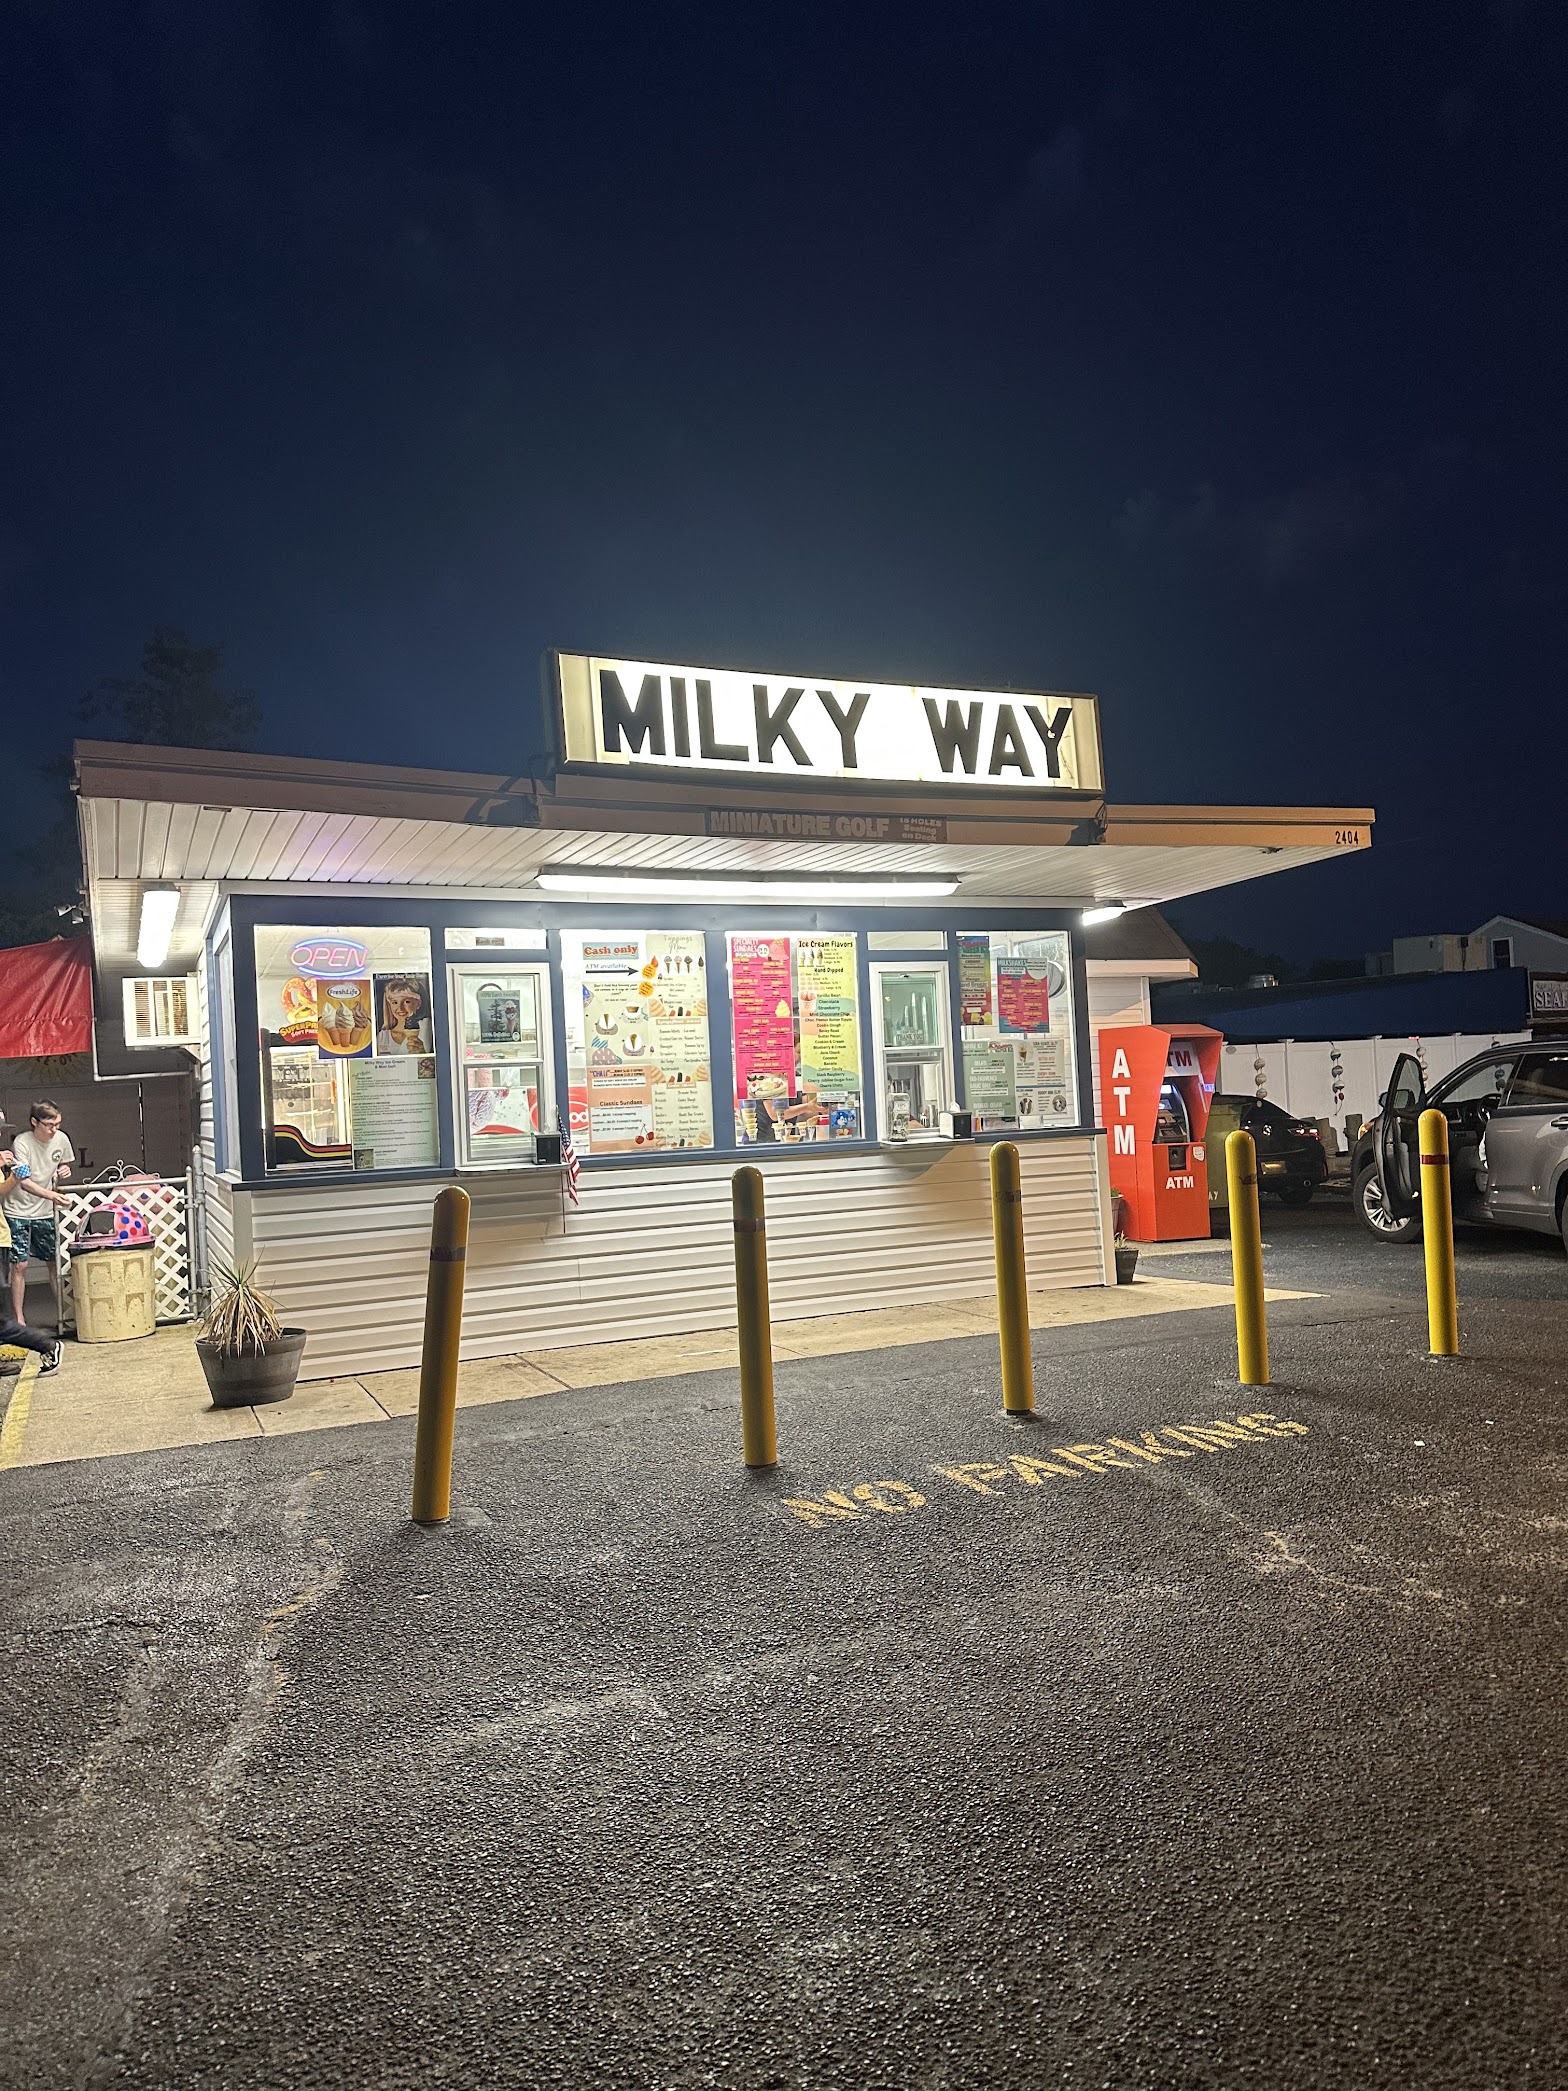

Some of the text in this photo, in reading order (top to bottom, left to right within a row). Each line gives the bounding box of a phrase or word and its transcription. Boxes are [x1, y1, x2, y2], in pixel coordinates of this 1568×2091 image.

[600, 669, 1073, 779] MILKY WAY
[711, 812, 889, 838] MINIATURE GOLF
[904, 824, 936, 834] Seating
[911, 818, 941, 827] HOLES
[915, 833, 936, 841] Deck
[1335, 830, 1359, 844] 2404
[664, 934, 692, 942] Toppings
[811, 940, 829, 948] Cream
[291, 947, 367, 966] OPEN
[584, 945, 637, 957] Cash only
[1112, 1049, 1136, 1155] ATM
[1166, 1175, 1194, 1189] ATM
[782, 1412, 1311, 1529] NO PARKING
